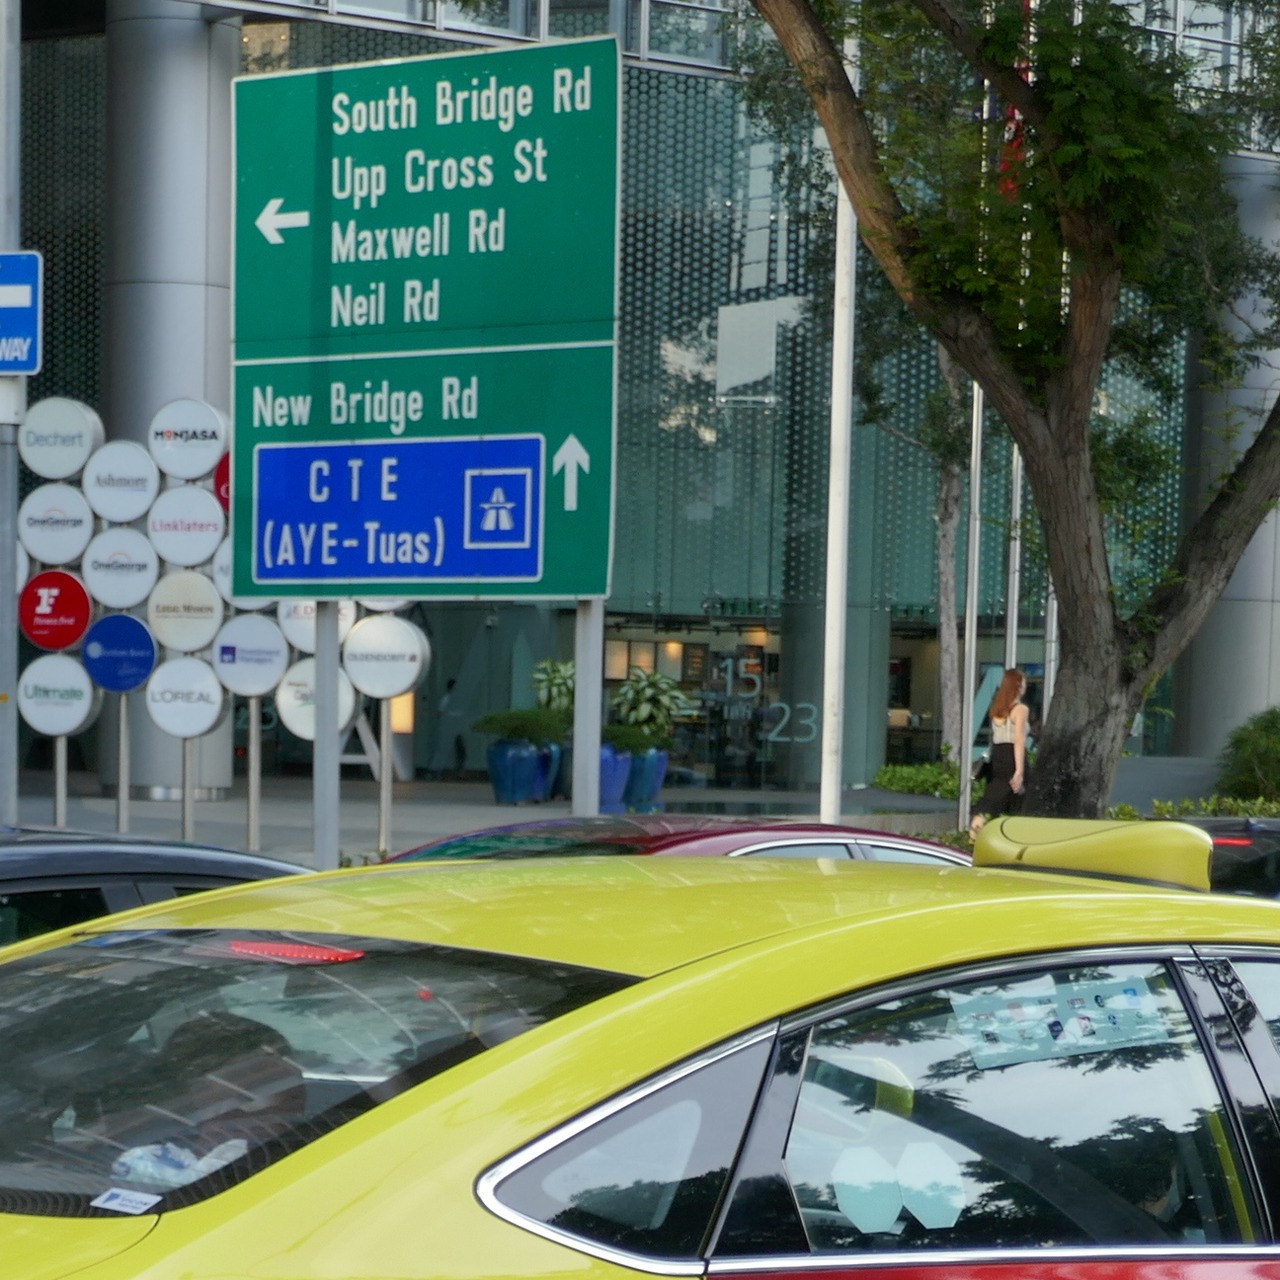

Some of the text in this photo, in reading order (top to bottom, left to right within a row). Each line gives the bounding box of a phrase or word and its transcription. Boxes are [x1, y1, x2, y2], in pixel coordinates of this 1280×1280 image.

[332, 65, 591, 135] South Bridge Rd
[332, 137, 548, 210] Upp Cross St
[331, 208, 505, 264] Maxwell Rd
[331, 278, 439, 328] Neil Rd
[253, 376, 478, 435] New Bridge Rd
[25, 431, 83, 448] Dechert
[93, 474, 148, 488] Ashmore
[151, 519, 219, 533] Linklaters
[263, 516, 445, 568] (AYE-Tuas)
[24, 685, 84, 700] Ultimate
[720, 657, 762, 698] 15
[767, 702, 819, 742] 23
